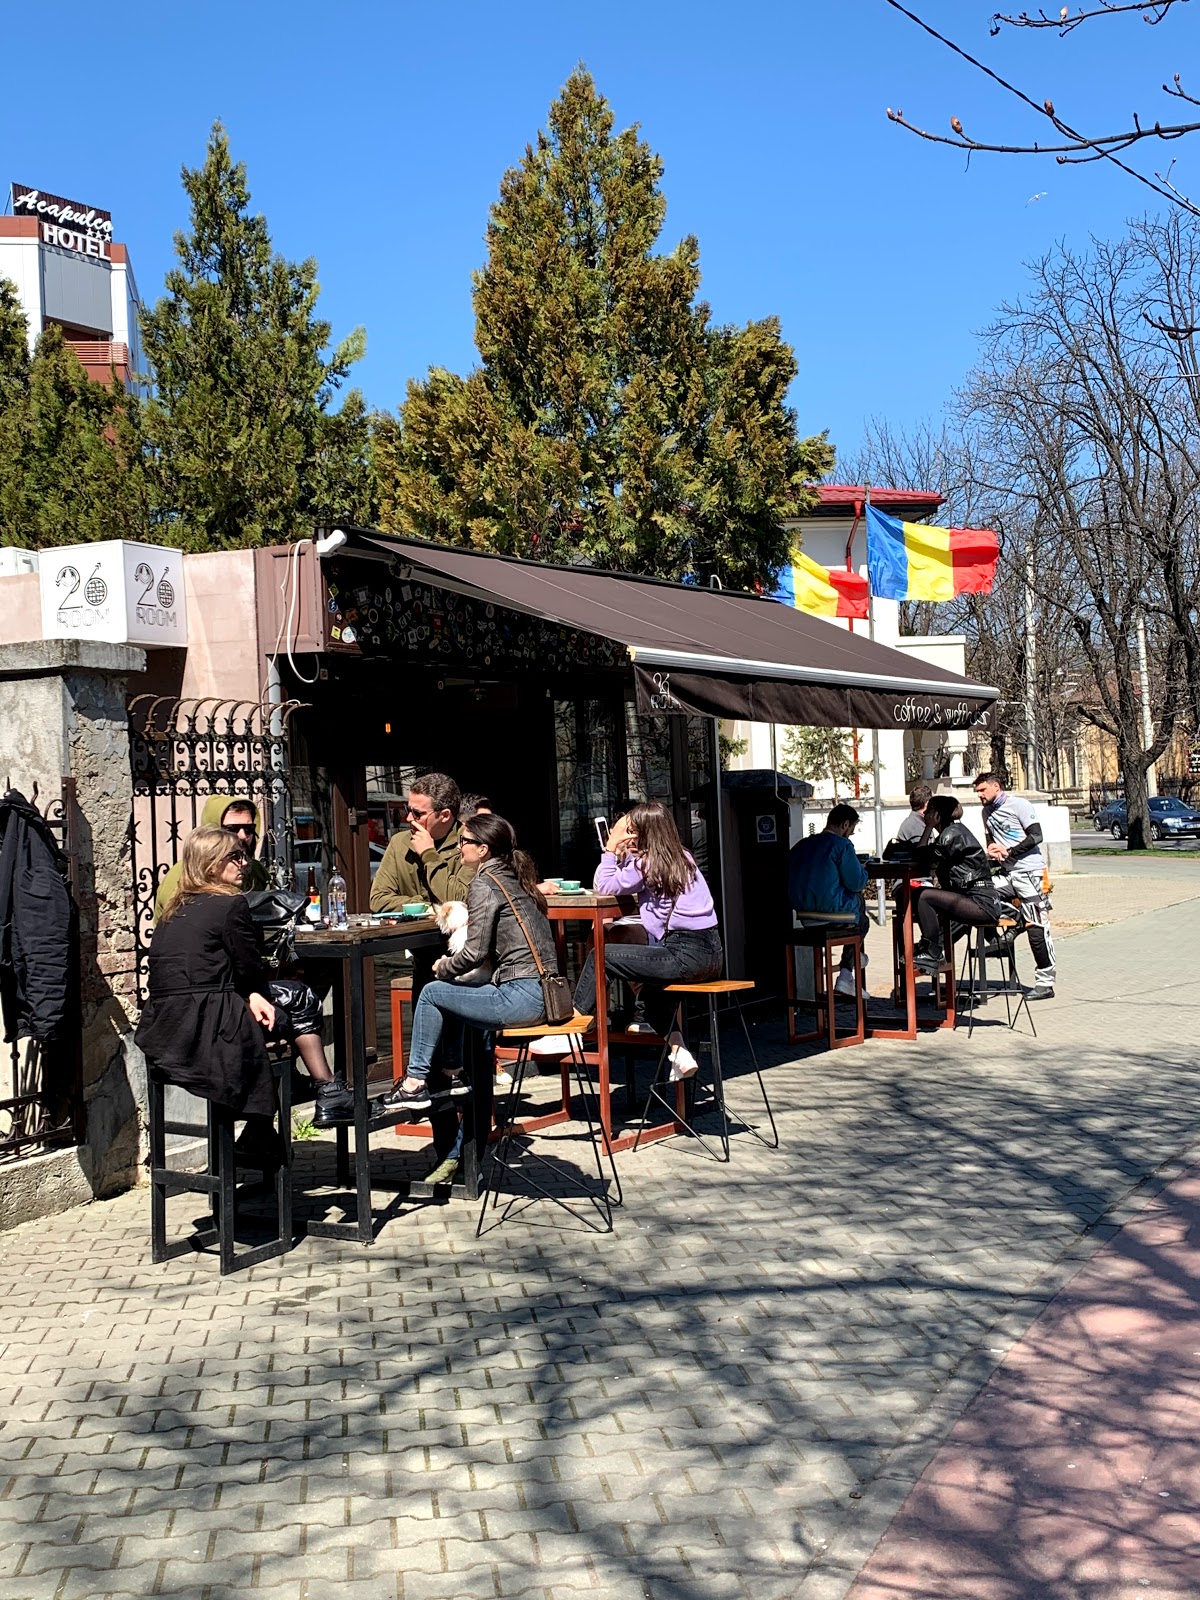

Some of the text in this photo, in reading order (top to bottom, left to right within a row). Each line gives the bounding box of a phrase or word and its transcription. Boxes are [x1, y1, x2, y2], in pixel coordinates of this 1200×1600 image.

[14, 191, 114, 232] Acapulco
[43, 223, 111, 261] HOTEL
[55, 562, 108, 610] 26
[134, 562, 175, 608] 26
[56, 608, 112, 628] ROOM
[136, 607, 177, 628] ROOM
[893, 697, 931, 723] coffee
[933, 703, 942, 724] &
